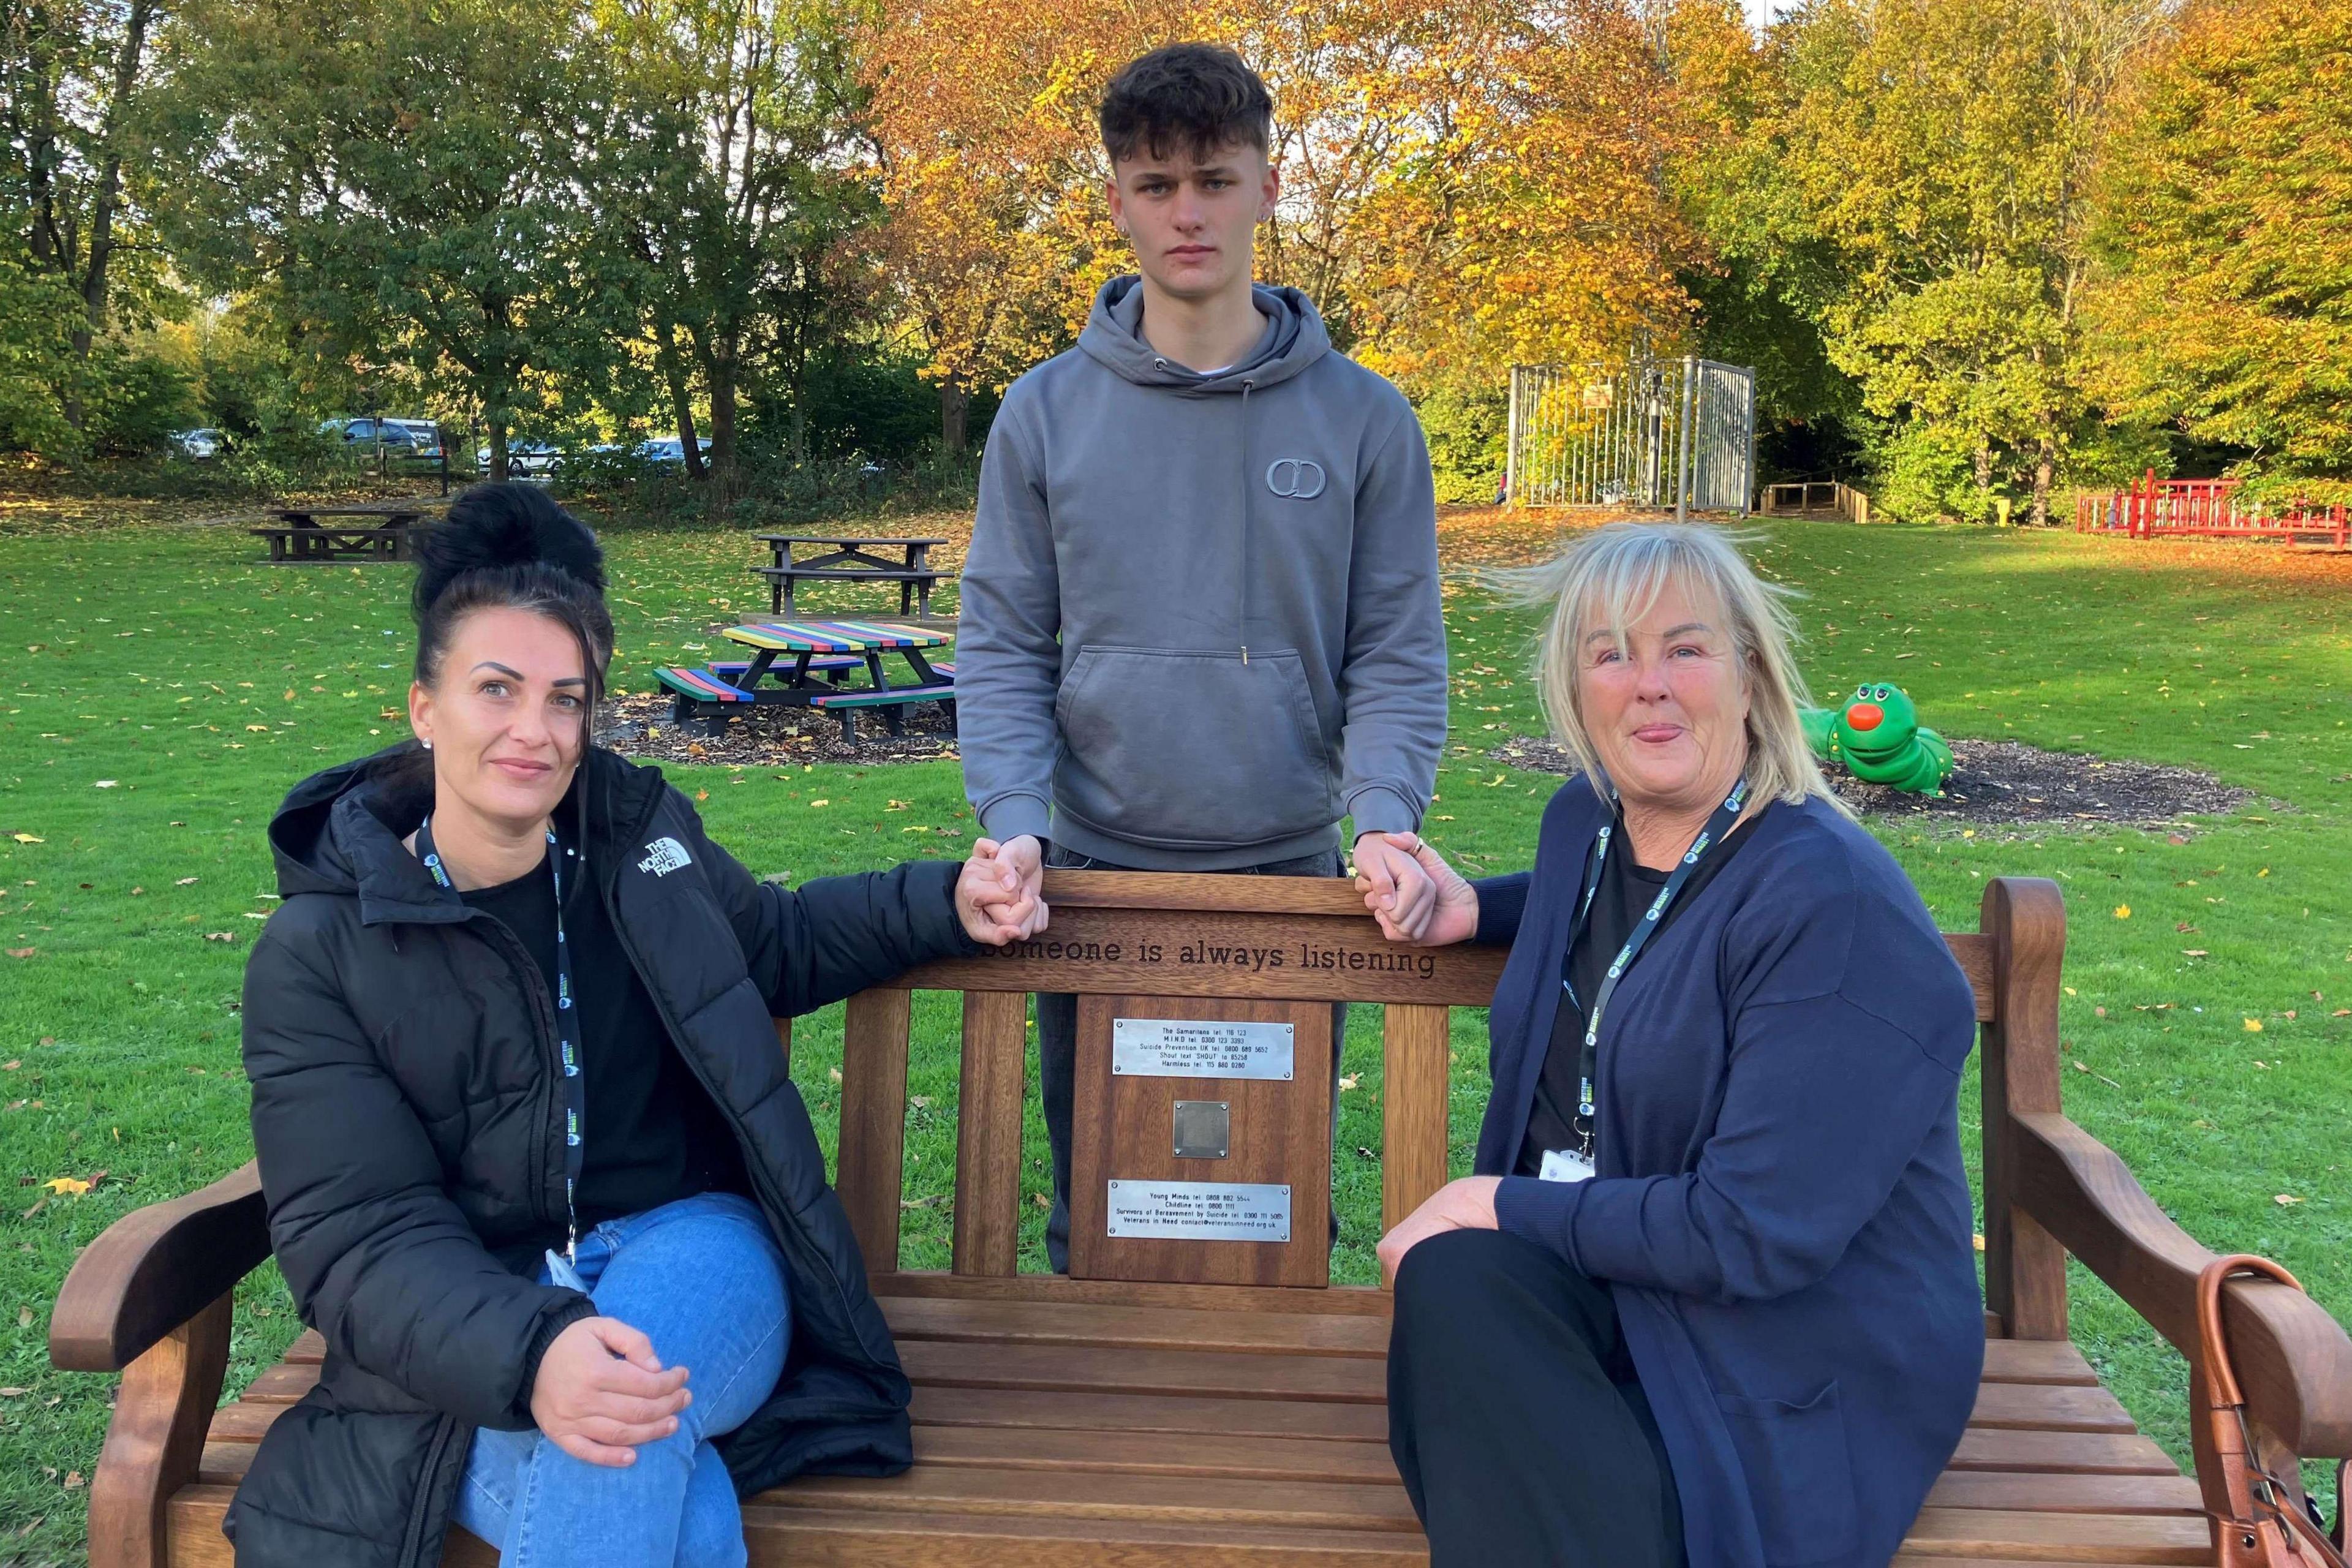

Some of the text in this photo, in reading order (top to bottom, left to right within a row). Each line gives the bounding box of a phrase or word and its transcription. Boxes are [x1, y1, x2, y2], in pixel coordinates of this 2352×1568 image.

[644, 837, 668, 854] THE
[638, 848, 673, 873] NORTH
[653, 858, 678, 877] FACE
[1138, 938, 1163, 962] is
[1180, 940, 1284, 973] always
[1301, 944, 1436, 980] listening
